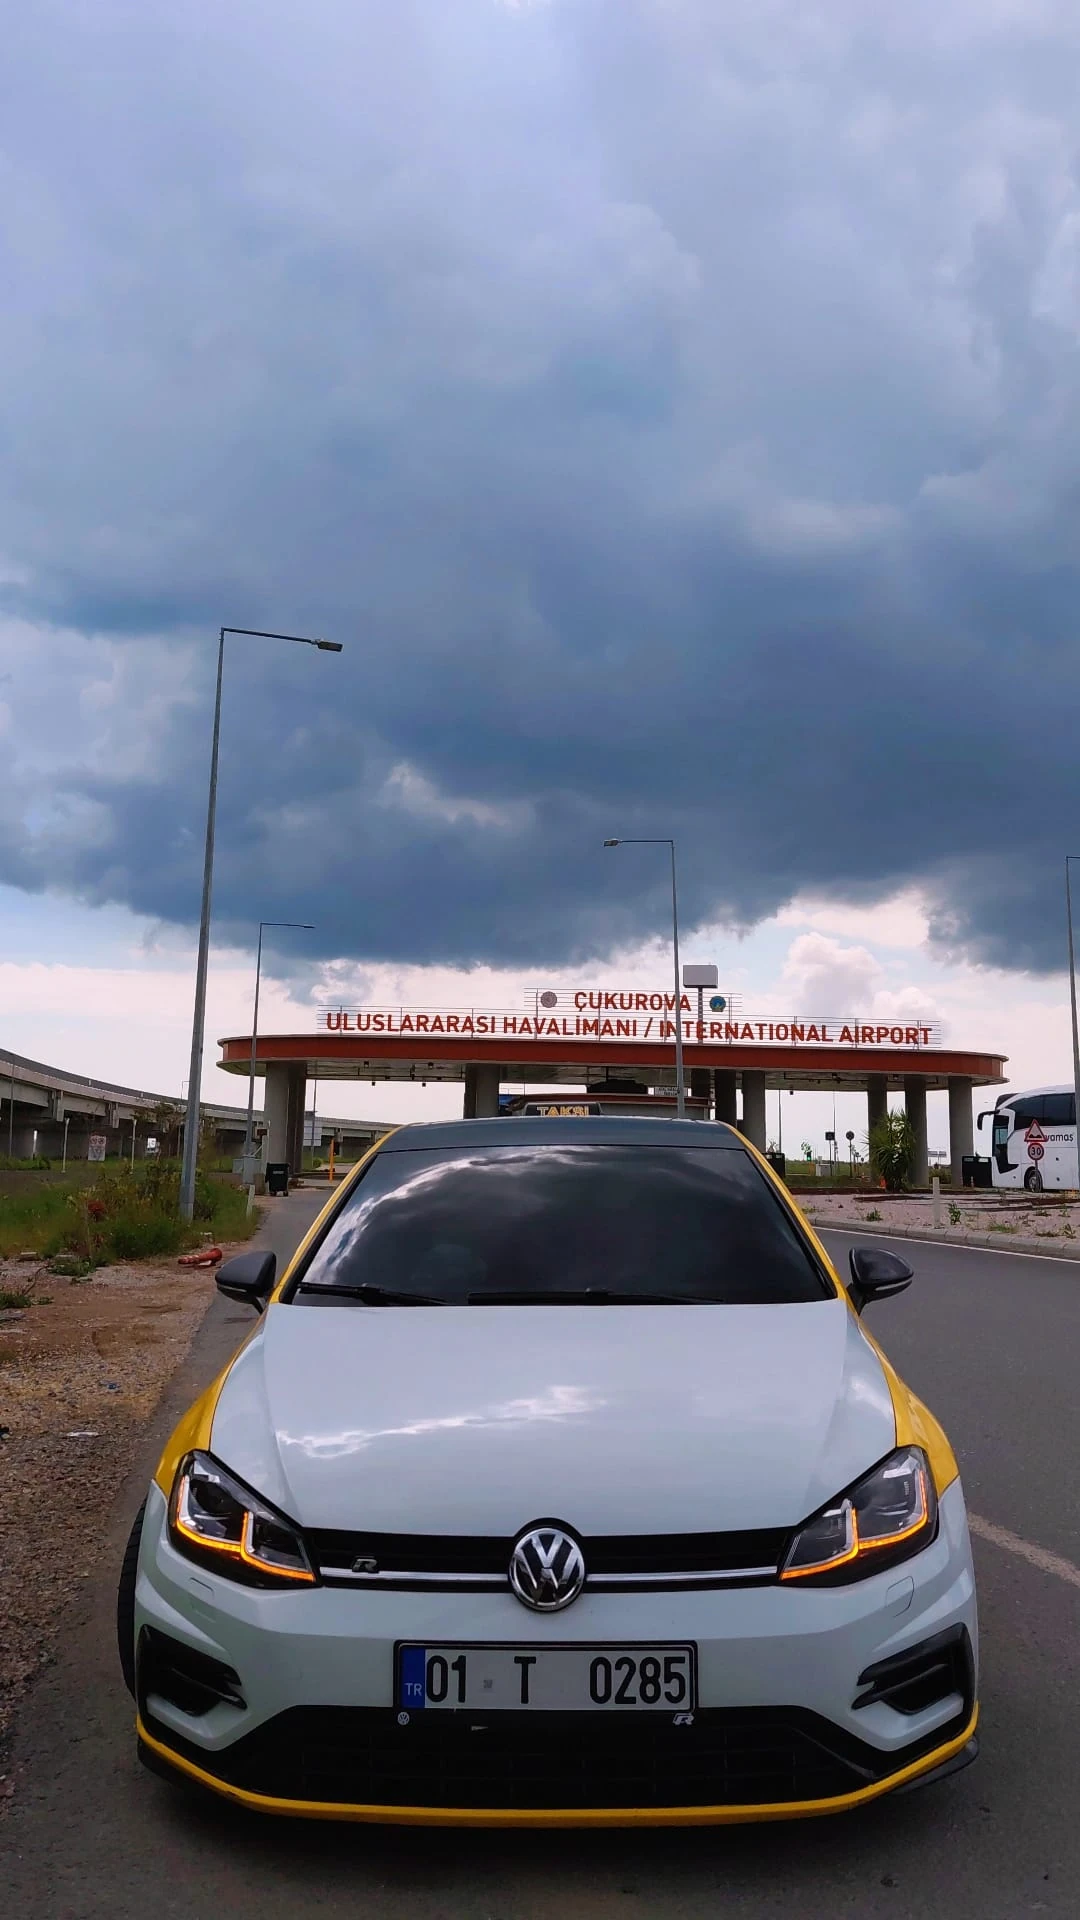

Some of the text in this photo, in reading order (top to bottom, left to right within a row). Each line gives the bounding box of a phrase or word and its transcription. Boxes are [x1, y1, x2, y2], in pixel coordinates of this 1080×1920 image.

[574, 991, 692, 1013] ÇUKUROVA
[326, 1012, 933, 1045] ULUSLARARASI HAVALİMANI / INTERNATIONAL AIRPORT
[1030, 1146, 1042, 1156] 30
[404, 1682, 423, 1697] TR
[426, 1654, 687, 1705] 01 T 0285
